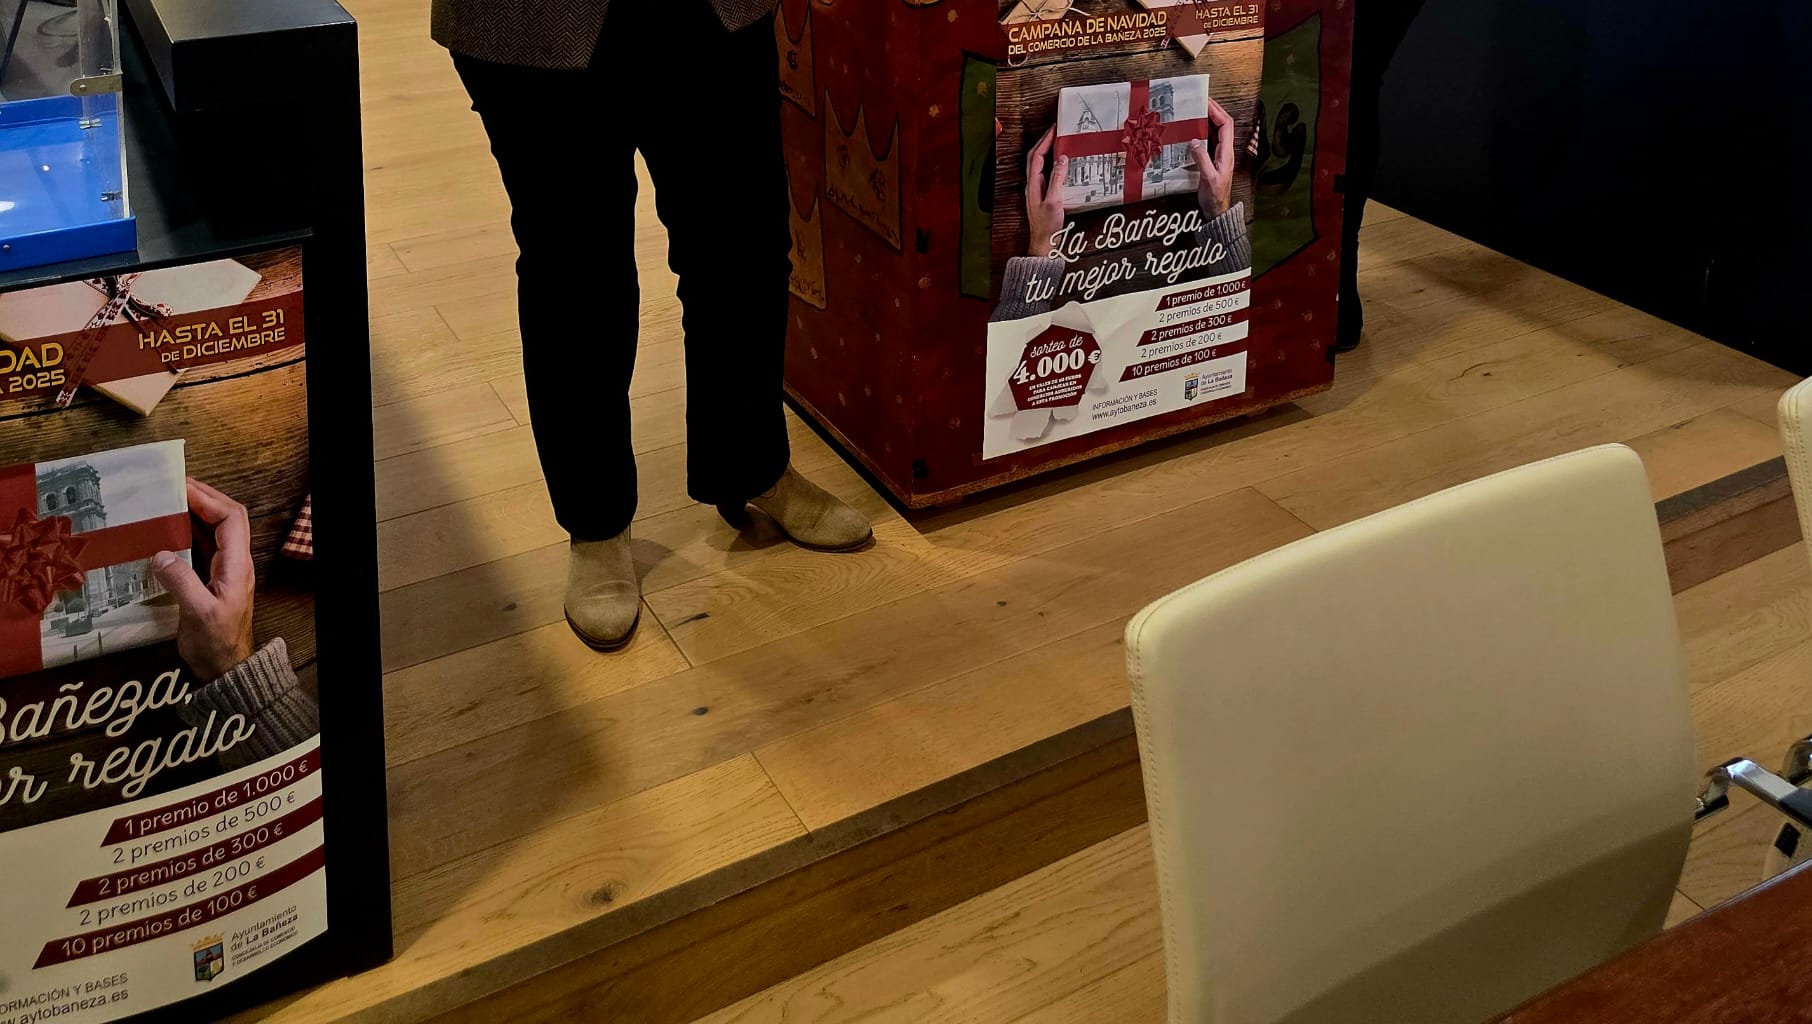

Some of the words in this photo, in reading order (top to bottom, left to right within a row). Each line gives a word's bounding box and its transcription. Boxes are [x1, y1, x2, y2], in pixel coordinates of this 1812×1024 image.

[1009, 18, 1082, 43] CAMPAÑA
[1086, 17, 1104, 32] DE
[1108, 11, 1167, 31] NAVIDAD
[1196, 7, 1231, 20] HASTA
[1233, 5, 1246, 16] EL
[1248, 4, 1259, 14] 31
[1213, 16, 1259, 28] DICIEMBRE
[1008, 44, 1027, 55] DEL
[1028, 37, 1075, 53] COMERCIO
[1077, 36, 1090, 47] DE
[1091, 34, 1103, 45] LA
[1105, 30, 1141, 43] BAÑEZA
[1143, 27, 1167, 39] 2025
[1048, 221, 1087, 263] La
[1095, 209, 1203, 249] Bañeza,
[1025, 273, 1053, 303] tu
[1059, 257, 1136, 301] mejor
[1145, 238, 1227, 284] regalo
[1166, 296, 1170, 306] 1
[1172, 291, 1203, 307] premio
[1204, 287, 1215, 297] de
[1216, 281, 1240, 295] 1.000
[1241, 280, 1246, 289] €
[1159, 313, 1165, 323] 2
[1166, 306, 1201, 323] premios
[1203, 302, 1214, 312] de
[1215, 297, 1233, 310] 500
[1234, 297, 1240, 306] €
[138, 321, 223, 349] HASTA
[229, 315, 257, 335] EL
[262, 309, 284, 328] 31
[1151, 331, 1157, 341] 2
[1159, 324, 1193, 341] premios
[1195, 320, 1206, 330] de
[1208, 315, 1226, 328] 300
[1227, 315, 1233, 323] €
[161, 350, 180, 363] DE
[183, 327, 286, 359] DICIEMBRE
[1030, 340, 1066, 358] sorteo
[1069, 334, 1083, 348] de
[1141, 348, 1147, 358] 2
[1148, 341, 1184, 359] premios
[1186, 338, 1197, 348] de
[1198, 332, 1216, 345] 200
[1217, 332, 1223, 341] €
[1013, 348, 1085, 385] 4.000
[1088, 349, 1101, 365] €
[1132, 366, 1143, 376] 10
[1144, 358, 1179, 375] premios
[1181, 354, 1192, 365] de
[1194, 349, 1210, 361] 100
[1211, 349, 1217, 357] €
[9, 369, 65, 392] 2025
[1092, 399, 1157, 421] www.aytobaneza.es
[1093, 395, 1133, 410] INFORMACIÓN
[1134, 393, 1138, 401] Y
[1138, 389, 1158, 400] BASES
[68, 709, 256, 798] regalo
[124, 819, 133, 836] 1
[140, 799, 209, 837] premio
[214, 790, 239, 808] de
[243, 764, 295, 797] 1.000
[298, 759, 308, 773] €
[112, 847, 124, 865] 2
[131, 826, 210, 864] premios
[215, 815, 239, 833] de
[244, 795, 282, 823] 500
[286, 790, 296, 804] €
[98, 878, 111, 896] 2
[116, 856, 197, 895] premios
[202, 846, 226, 865] de
[231, 827, 269, 855] 300
[273, 822, 285, 837] €
[79, 909, 92, 926] 2
[97, 888, 178, 926] premios
[183, 877, 208, 896] de
[213, 860, 251, 888] 200
[255, 856, 266, 870] €
[62, 937, 87, 958] 10
[92, 915, 173, 955] premios
[178, 905, 202, 925] de
[208, 889, 243, 912] 100
[247, 885, 258, 900] €
[231, 905, 297, 941] Ayuntamiento
[231, 941, 243, 952] de
[246, 934, 259, 945] La
[262, 914, 298, 937] Bañeza
[73, 983, 82, 996] Y
[85, 972, 128, 994] BASES
